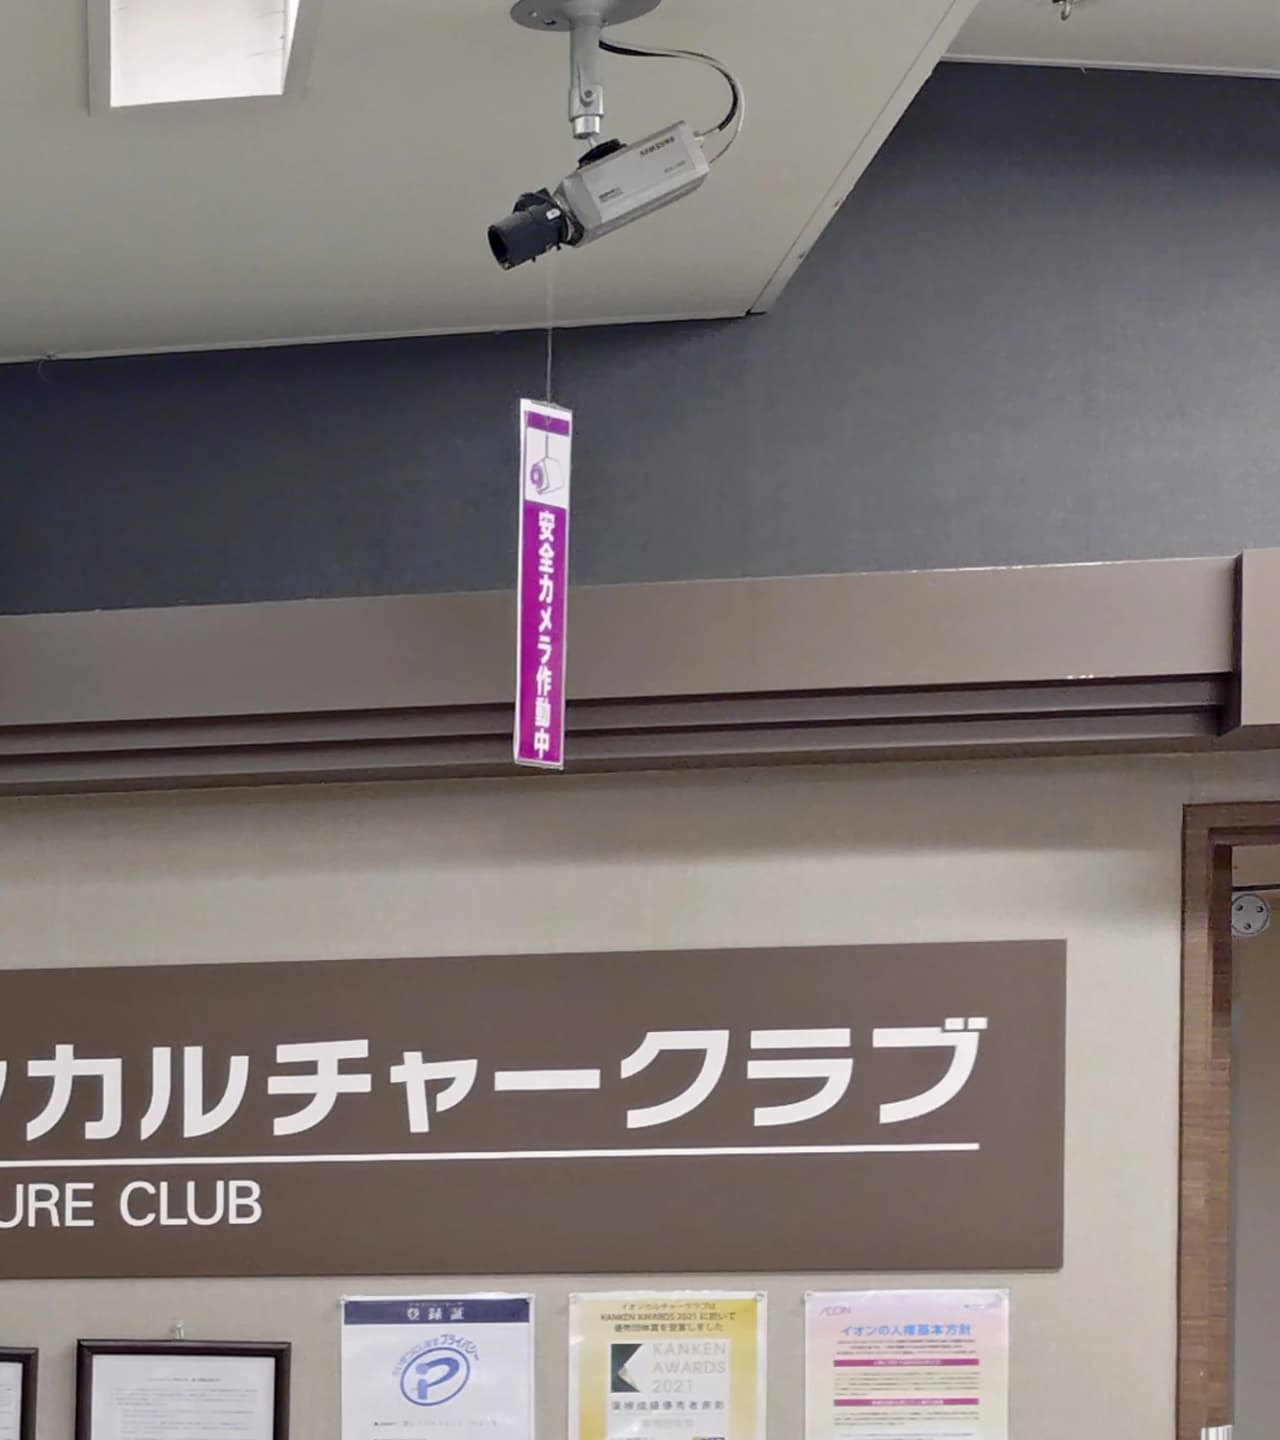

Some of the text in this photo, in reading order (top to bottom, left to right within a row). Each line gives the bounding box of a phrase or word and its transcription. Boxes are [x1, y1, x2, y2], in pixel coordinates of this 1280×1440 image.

[533, 509, 556, 760] 安全カメラ作動中
[119, 1179, 264, 1226] CLUB
[652, 1342, 728, 1356] KANKEN
[652, 1360, 728, 1375] AWARDS
[652, 1378, 694, 1393] 2021
